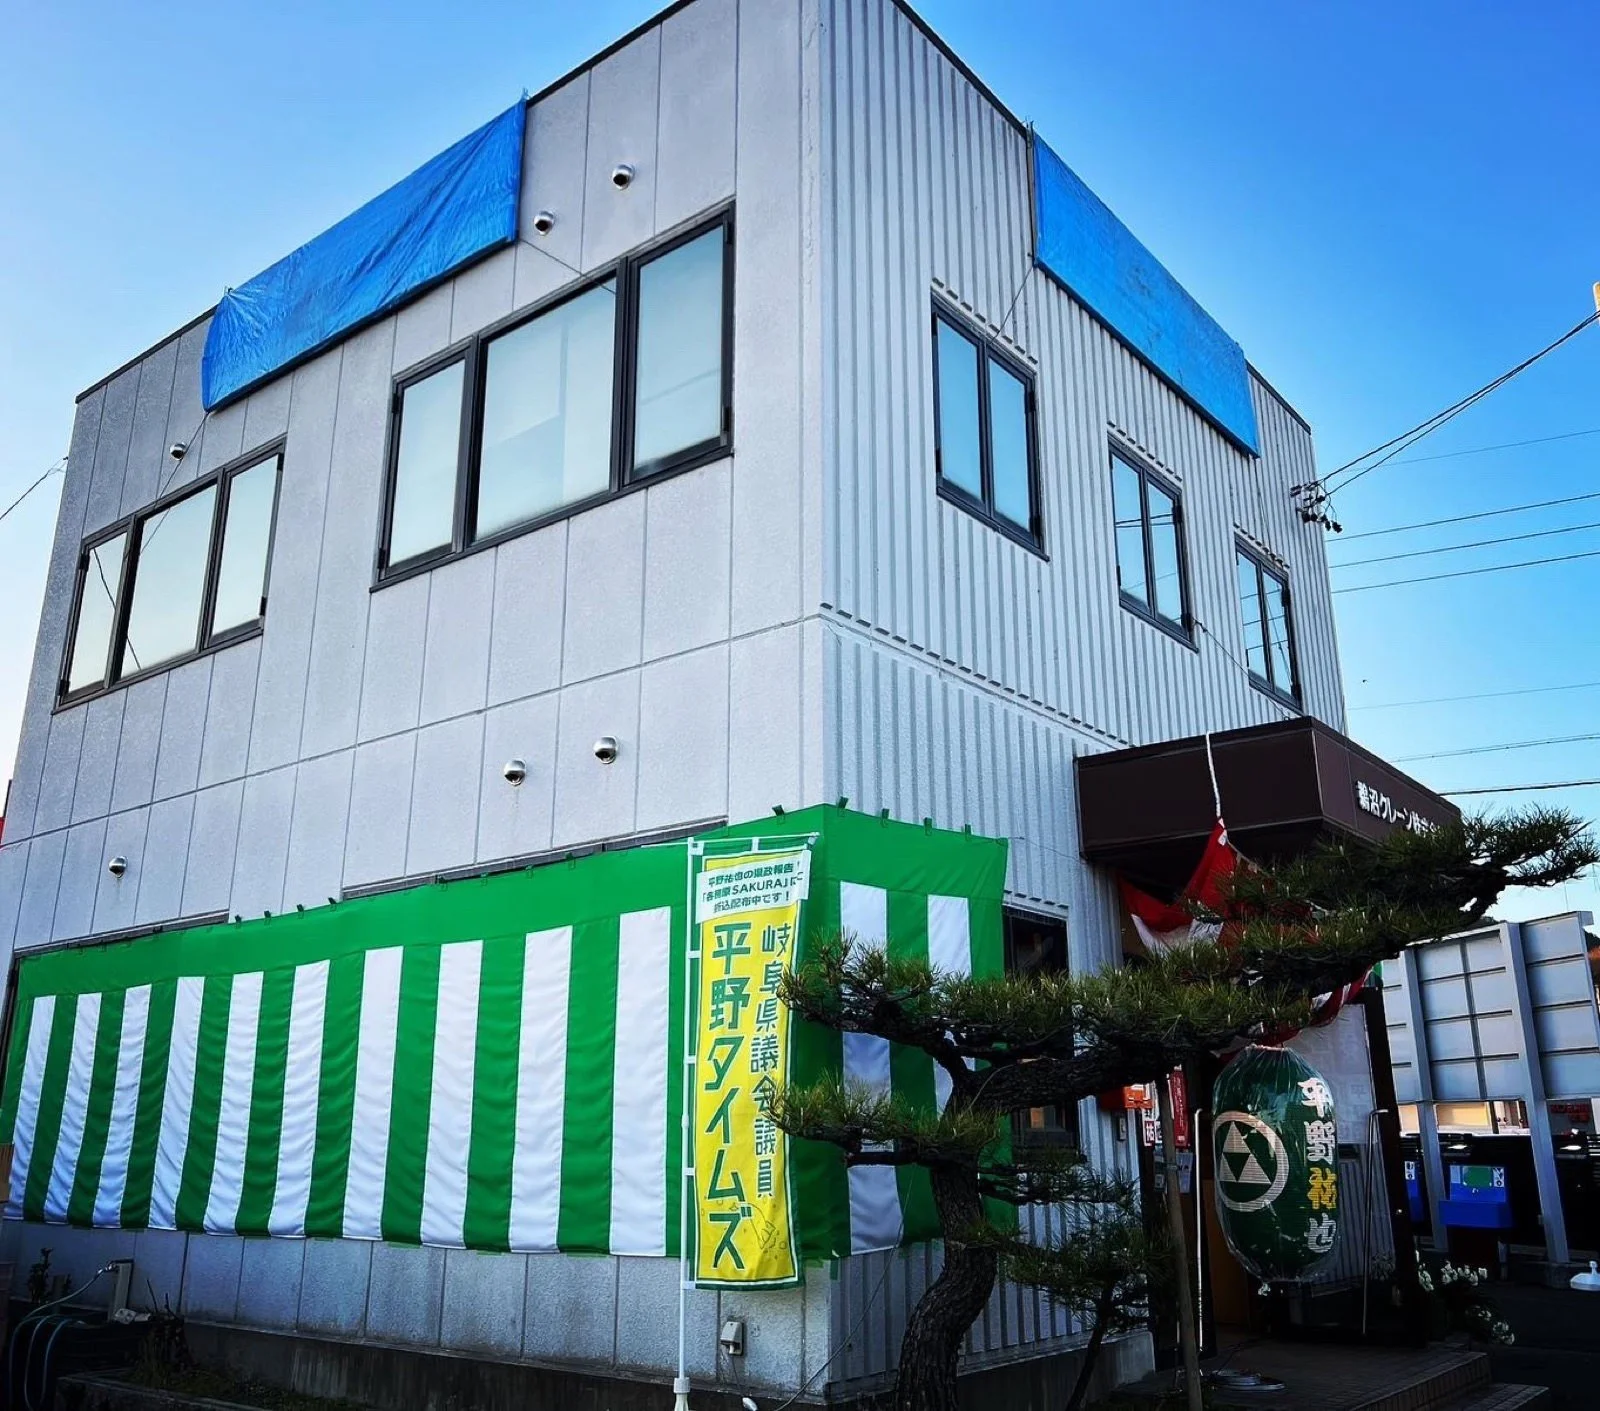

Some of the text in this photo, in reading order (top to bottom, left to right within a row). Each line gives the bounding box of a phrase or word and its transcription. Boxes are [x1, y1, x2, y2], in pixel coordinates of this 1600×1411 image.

[704, 922, 752, 1269] 平野タイムズ
[750, 922, 791, 1198] 岐阜県議会議員
